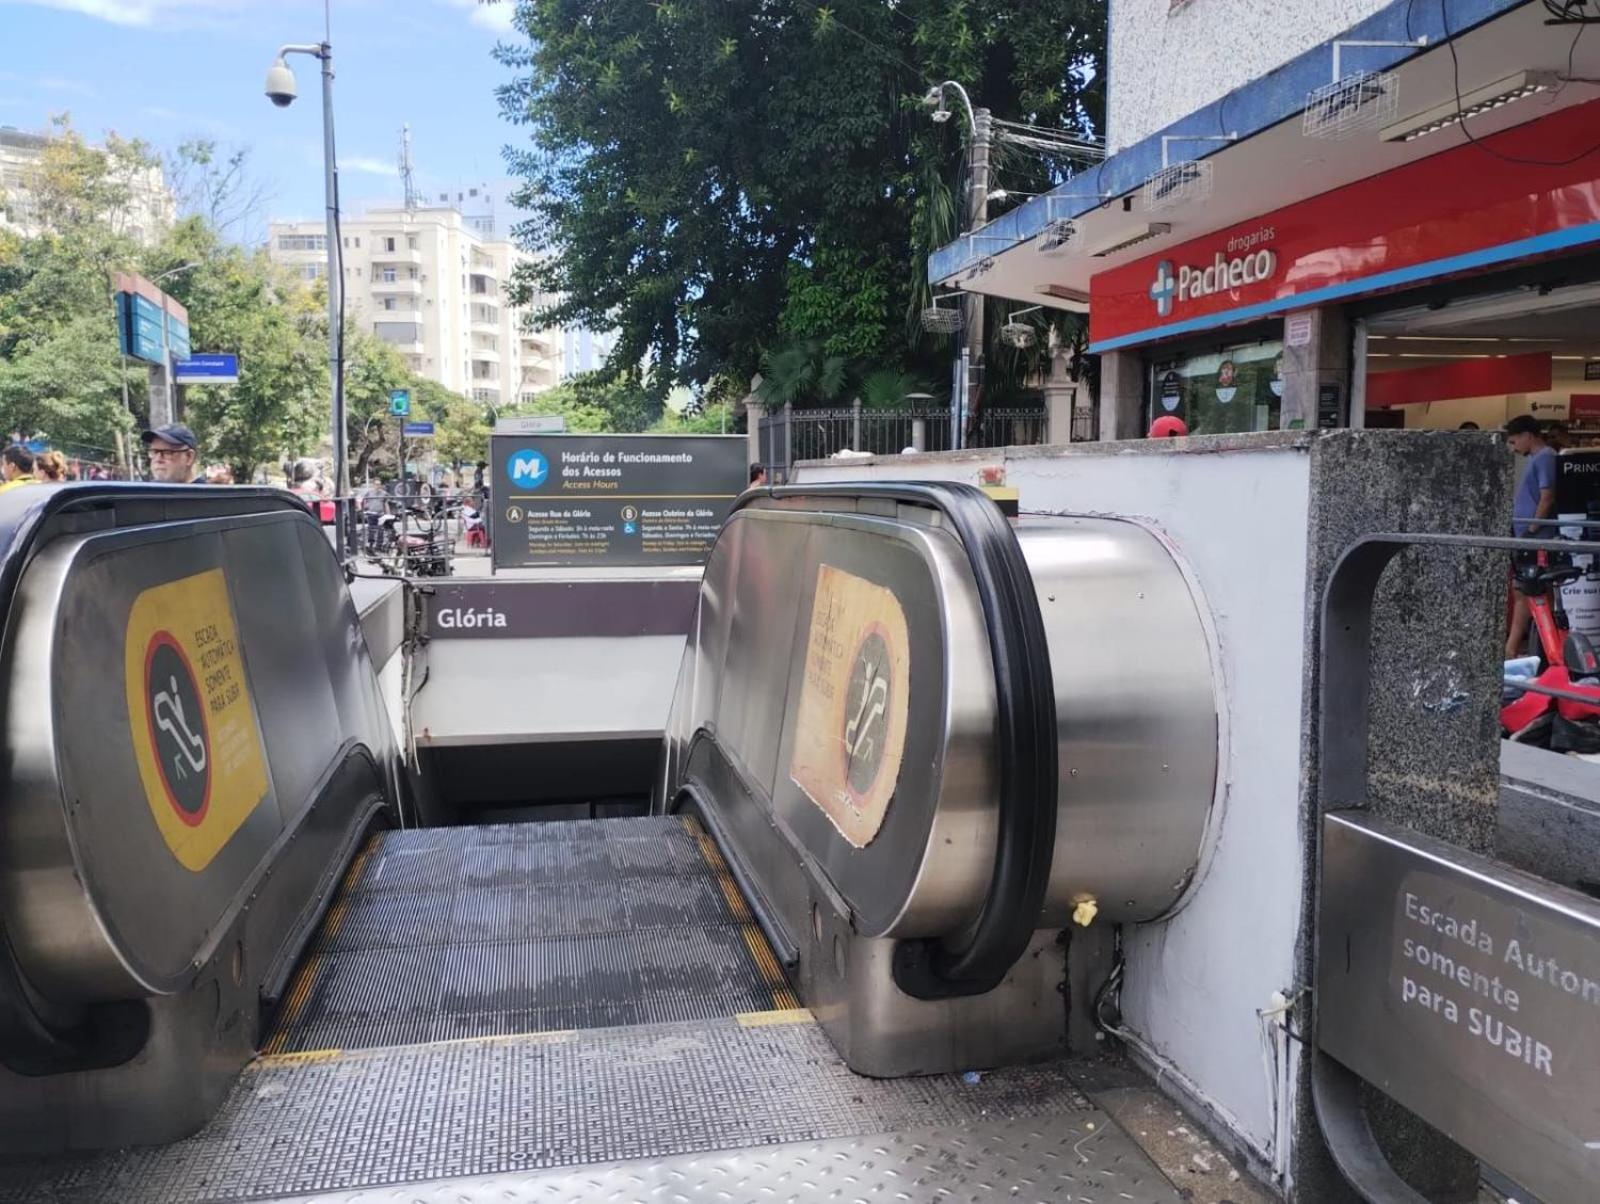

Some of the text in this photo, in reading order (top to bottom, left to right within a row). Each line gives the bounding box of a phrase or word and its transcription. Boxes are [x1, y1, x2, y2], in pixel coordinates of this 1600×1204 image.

[1226, 225, 1277, 254] drogarias
[1178, 246, 1275, 302] Pacheco
[562, 451, 693, 464] Horário de Funcionamento
[562, 465, 622, 477] dos Acessos
[562, 480, 618, 489] Access Hours
[510, 509, 519, 520] A
[437, 607, 508, 629] Glória
[194, 624, 218, 648] ESCADA
[205, 664, 232, 695] SOMENTE
[210, 695, 225, 715] PARA
[1405, 892, 1493, 955] Escada
[1403, 937, 1522, 1013] somente
[1401, 974, 1554, 1077] para SUBIR
